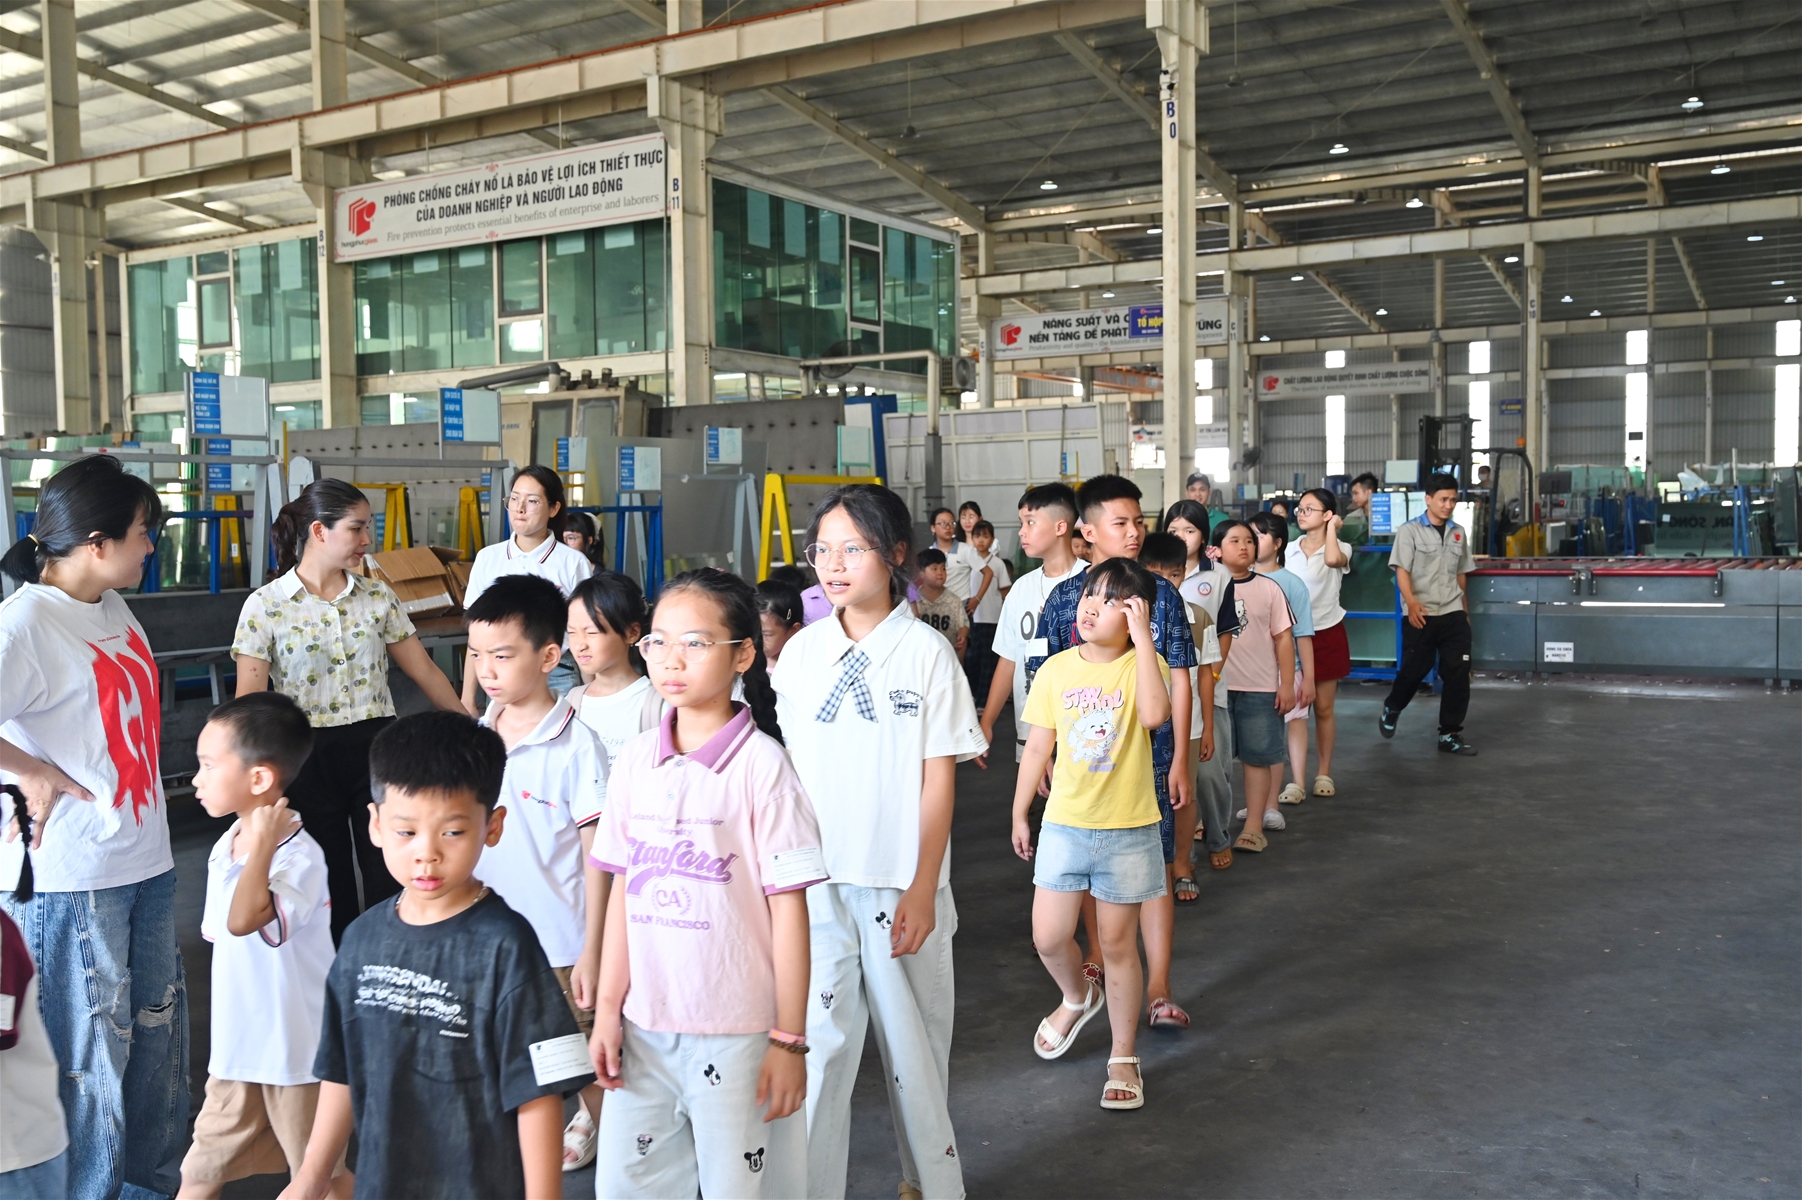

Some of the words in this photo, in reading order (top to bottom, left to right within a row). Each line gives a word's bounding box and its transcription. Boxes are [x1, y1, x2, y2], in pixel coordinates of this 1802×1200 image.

[1166, 101, 1175, 118] B
[384, 190, 416, 208] PHÒNG
[418, 182, 451, 202] CHỐNG
[454, 178, 481, 197] CHÁY
[484, 173, 498, 191] NỔ
[501, 173, 514, 189] LÀ
[517, 168, 537, 186] BẢO
[541, 166, 554, 182] VỆ
[557, 164, 574, 182] LỢI
[577, 160, 596, 177] ÍCH
[599, 151, 630, 173] THIẾT
[634, 149, 663, 168] THỰC
[673, 178, 680, 192] B
[416, 204, 436, 222] CỦA
[438, 202, 472, 219] DOANH
[475, 195, 513, 214] NGHIỆP
[516, 190, 529, 207] VÀ
[532, 184, 565, 204] NGƯỜI
[569, 183, 589, 199] LAO
[592, 177, 623, 196] ĐỘNG
[671, 196, 680, 210] 11
[386, 231, 400, 242] Fire
[402, 225, 443, 244] prevention
[444, 221, 476, 239] protects
[477, 213, 512, 230] essential
[514, 209, 547, 224] benefits
[549, 207, 558, 218] of
[559, 201, 603, 220] enterprise
[604, 198, 621, 209] and
[623, 194, 660, 207] laborers
[318, 245, 325, 257] 12
[1075, 313, 1101, 327] SUẤT
[1105, 312, 1120, 324] VÀ
[1101, 327, 1128, 338] PHÁT
[1062, 685, 1102, 710] STAY
[656, 890, 682, 908] CA
[630, 914, 654, 924] SAN
